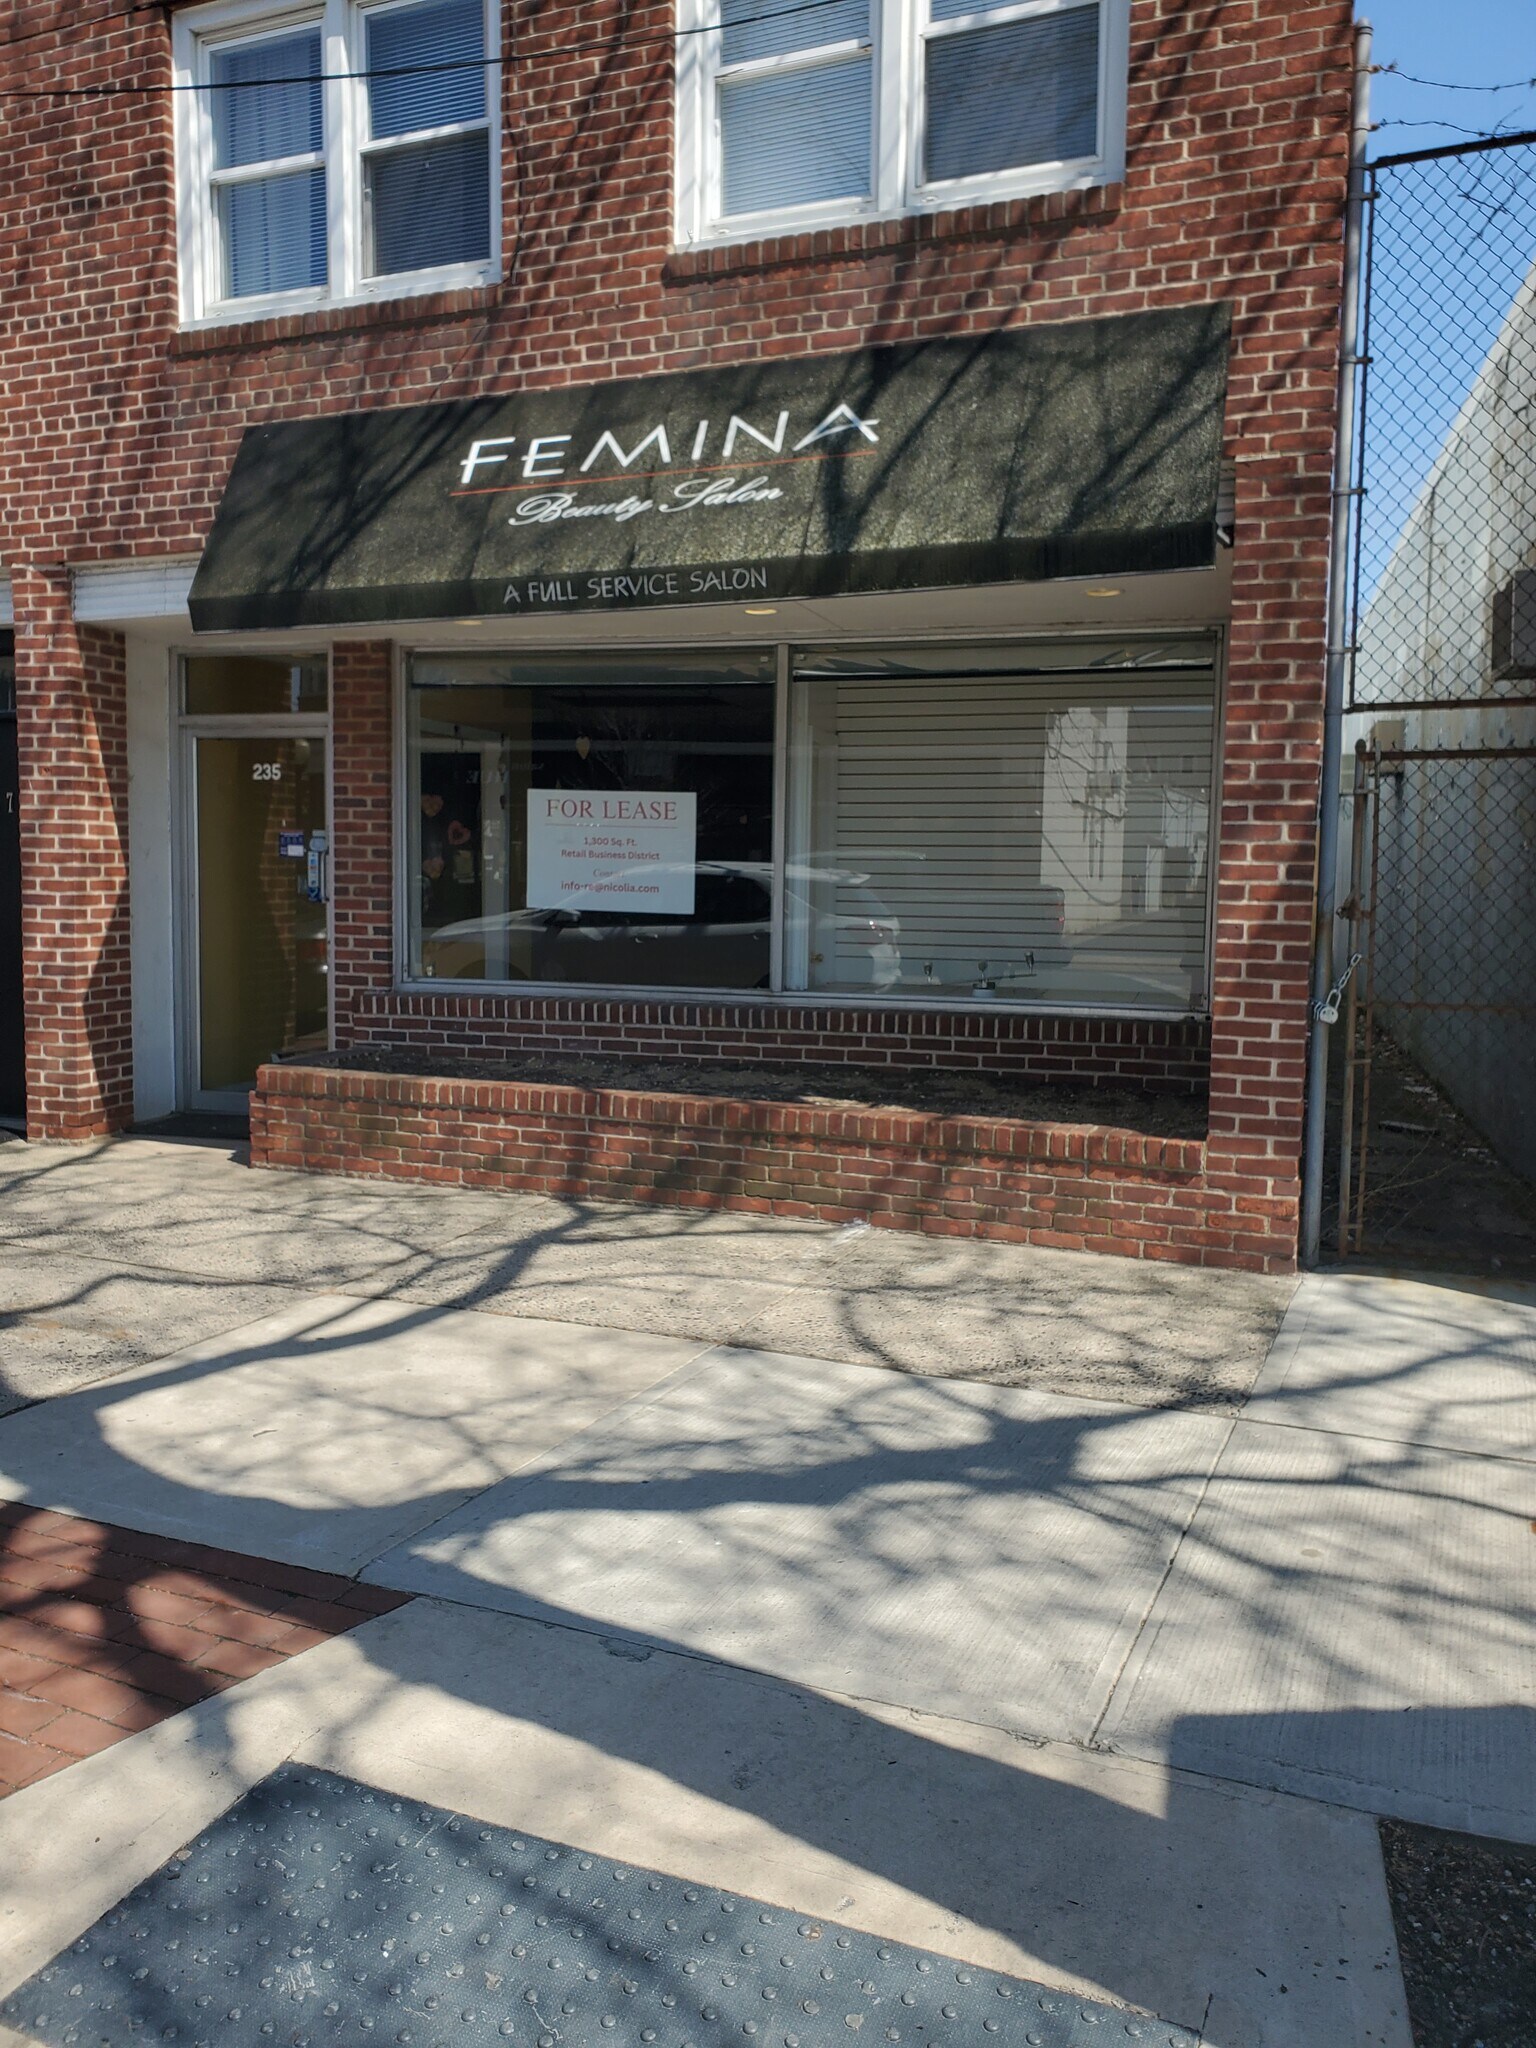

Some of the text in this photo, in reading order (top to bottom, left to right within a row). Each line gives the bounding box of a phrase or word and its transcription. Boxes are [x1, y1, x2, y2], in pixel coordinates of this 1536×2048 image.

[460, 403, 880, 484] FEMINA
[508, 475, 784, 526] Beauty Salon
[503, 566, 769, 605] A FULL SERVICE SALON
[252, 763, 281, 780] 235
[6, 792, 13, 813] 7
[546, 799, 678, 821] FOR LEASE
[584, 836, 638, 848] 1,300 Sq. Ft.
[561, 849, 660, 861] Retail Business District
